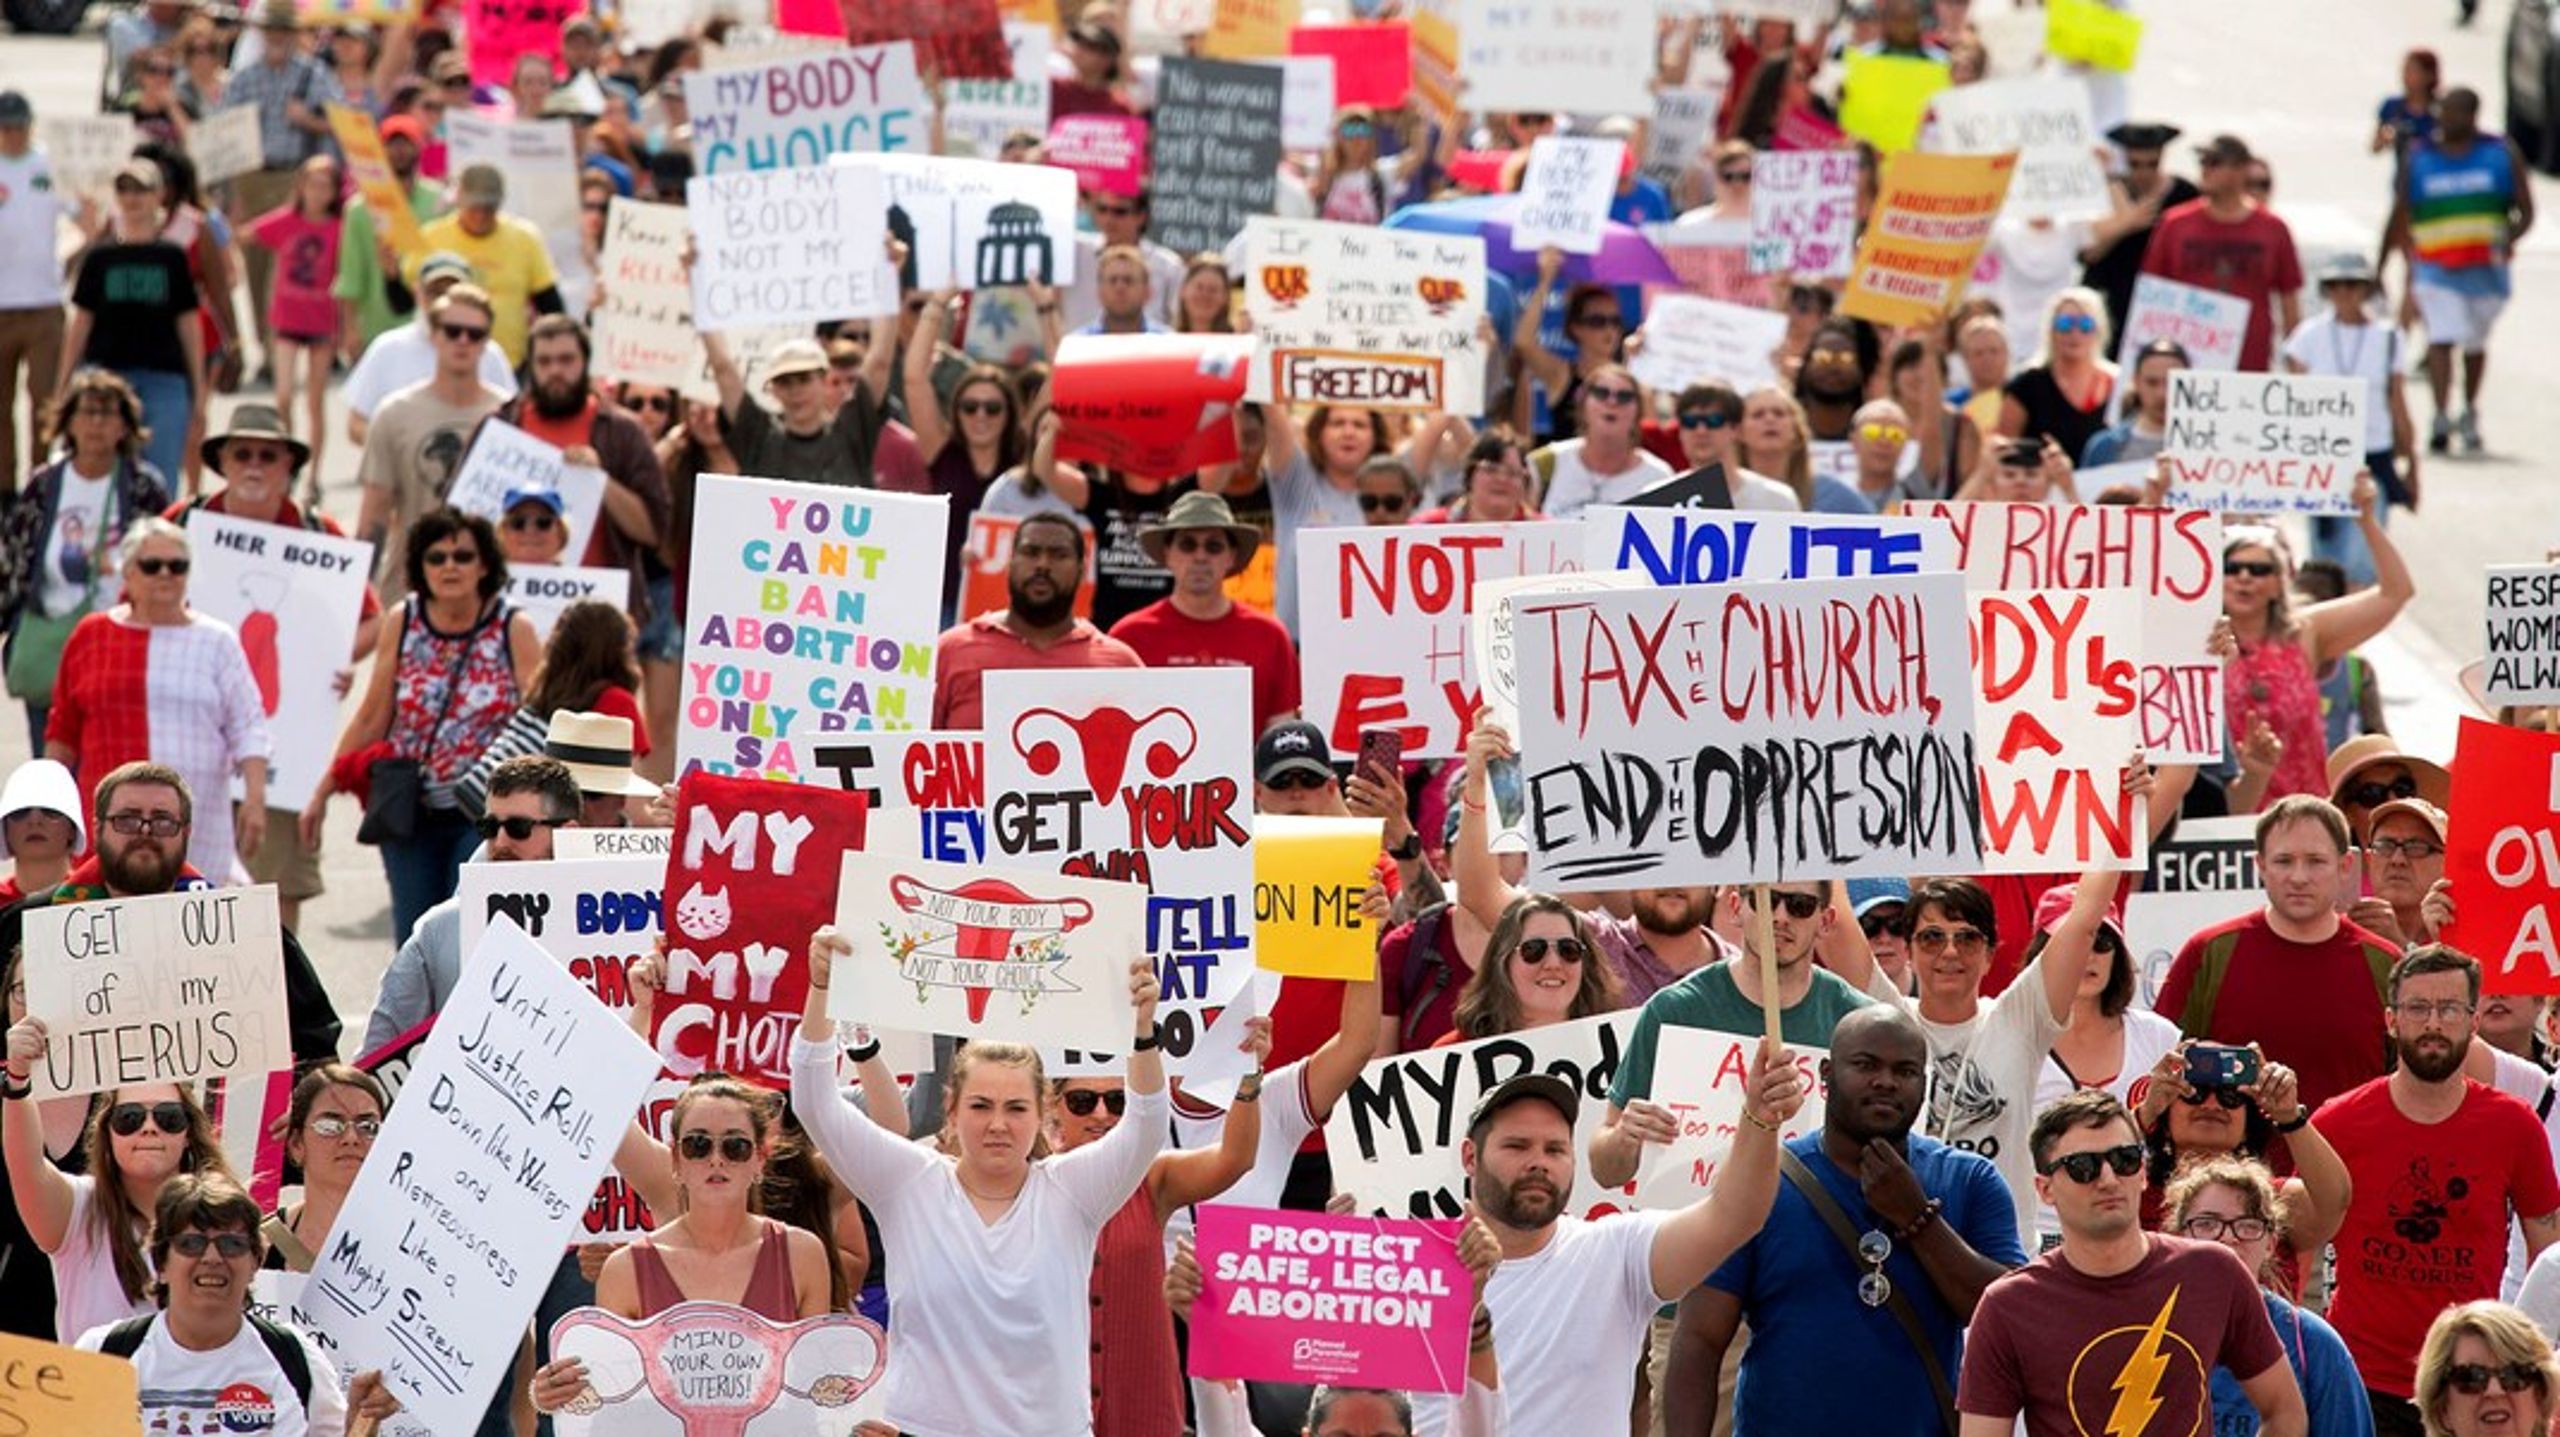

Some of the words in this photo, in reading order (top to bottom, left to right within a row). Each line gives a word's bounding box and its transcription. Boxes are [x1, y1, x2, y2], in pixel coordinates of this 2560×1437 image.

[715, 71, 760, 106] MY
[766, 50, 886, 117] BODY
[692, 111, 738, 141] MY
[708, 174, 772, 204] NOT
[796, 170, 839, 193] MY
[719, 243, 782, 272] NOT
[803, 238, 845, 268] MY
[1261, 264, 1309, 303] OUR
[1416, 275, 1467, 304] OUR
[1289, 354, 1433, 402] FREEDOM
[2173, 378, 2228, 413] Not
[2261, 379, 2356, 418] Church
[2169, 417, 2220, 452] Not
[2258, 423, 2353, 457] State
[2174, 457, 2335, 491] WOMEN
[769, 496, 872, 538] YOU
[214, 528, 266, 557] HER
[283, 545, 354, 574] BODY
[741, 539, 887, 581] CANT
[2000, 503, 2214, 602] RIGHTS
[525, 578, 596, 598] BODY
[1338, 535, 1503, 620] NOT
[2488, 574, 2560, 608] RESP
[760, 579, 866, 625] BAN
[699, 614, 932, 678] ABORTION
[1523, 599, 1688, 739] TAX
[1683, 620, 1708, 704] THE
[1720, 592, 1942, 726] CHURCH,
[1969, 593, 2089, 703] DY
[688, 662, 772, 701] YOU
[808, 677, 906, 718] CAN
[2487, 656, 2560, 692] ALW
[688, 696, 797, 738] ONLY
[2140, 665, 2220, 756] BATE
[734, 736, 798, 774] SA
[813, 746, 882, 808] I
[904, 741, 983, 809] CAN
[994, 790, 1094, 855] GET
[1120, 776, 1252, 852] YOUR
[1529, 748, 1664, 852] END
[1666, 758, 1691, 842] THE
[1693, 727, 1985, 884] OPPRESSION
[682, 803, 814, 877] MY
[486, 892, 551, 938] MY
[576, 890, 666, 935] BODY
[927, 894, 957, 917] NOT
[962, 900, 1000, 926] YOUR
[1009, 906, 1049, 928] BODY
[1145, 894, 1250, 953] TELL
[1254, 881, 1295, 923] ON
[1313, 884, 1367, 928] ME
[63, 905, 123, 959] GET
[181, 897, 239, 948] OUT
[85, 973, 119, 1016] of
[180, 975, 219, 1006] my
[665, 941, 789, 1004] MY
[910, 957, 944, 979] NOT
[950, 962, 988, 985] YOUR
[995, 964, 1046, 990] CHOICE
[1153, 953, 1219, 1001] AT
[490, 962, 579, 1057] Until
[45, 1011, 238, 1092] UTERUS
[657, 1001, 802, 1081] CHOI
[459, 1011, 541, 1109] Justice
[540, 1086, 598, 1162] Rolls
[1347, 1052, 1462, 1162] MY
[1473, 1022, 1622, 1101] Bod
[429, 1074, 484, 1147] Down
[485, 1124, 513, 1171] like
[455, 1169, 491, 1203] and
[398, 1220, 440, 1276] Like
[444, 1275, 459, 1298] a
[1249, 1223, 1422, 1263] PROTECT
[2362, 1236, 2475, 1268] GONER
[1215, 1252, 1321, 1290] SAFE,
[1332, 1260, 1450, 1296] LEGAL
[2362, 1258, 2475, 1284] RECORDS
[1227, 1286, 1433, 1329] ABORTION
[662, 1352, 714, 1375] YOUR
[722, 1353, 764, 1370] OWN
[673, 1331, 745, 1350] MIND
[681, 1374, 752, 1399] UTERUS!
